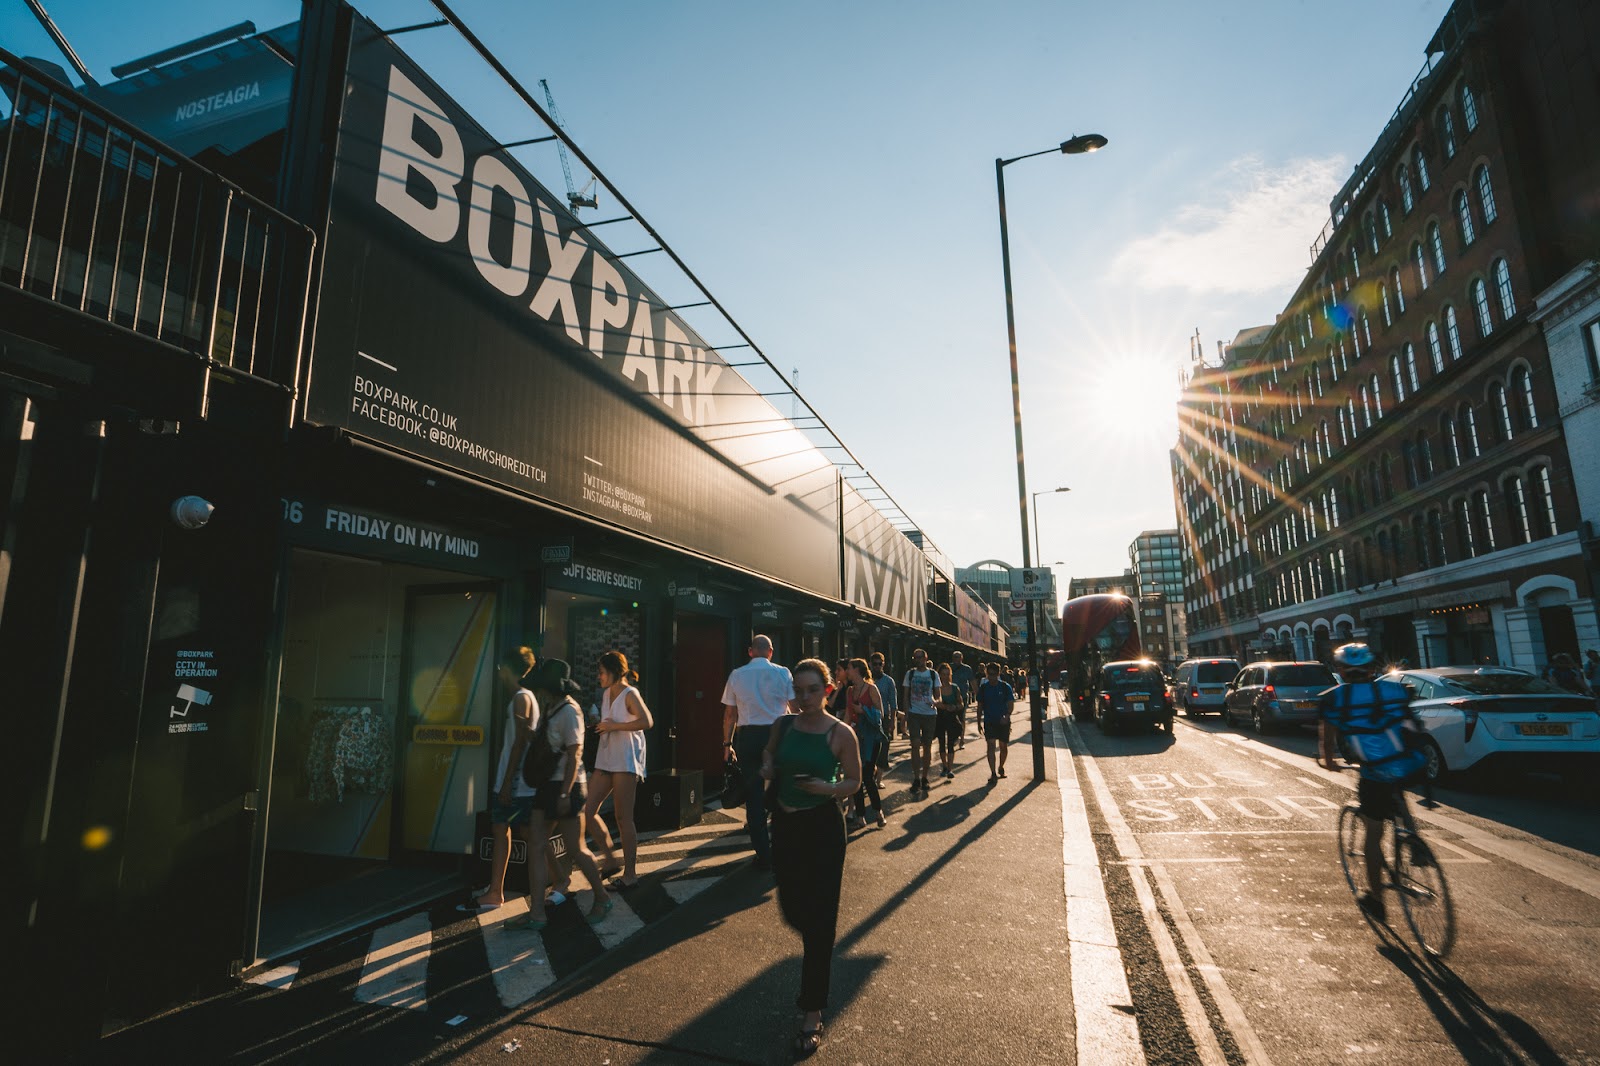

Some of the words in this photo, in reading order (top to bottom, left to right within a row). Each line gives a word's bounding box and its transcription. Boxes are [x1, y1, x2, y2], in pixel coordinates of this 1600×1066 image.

[375, 64, 722, 429] BOXPARK
[354, 375, 458, 432] BOXPARK.CO.UK
[325, 508, 390, 540] FRIDAY
[394, 524, 416, 546] ON
[420, 529, 443, 551] MY
[445, 535, 479, 558] MIND
[586, 566, 612, 585] SERVE
[613, 572, 642, 591] SOCIETY
[175, 661, 197, 669] CCTV
[198, 661, 206, 669] IN
[177, 650, 213, 658] @BOXPARK
[175, 669, 218, 677] OPERATION
[1128, 770, 1267, 791] BUS
[1127, 795, 1341, 822] STOP
